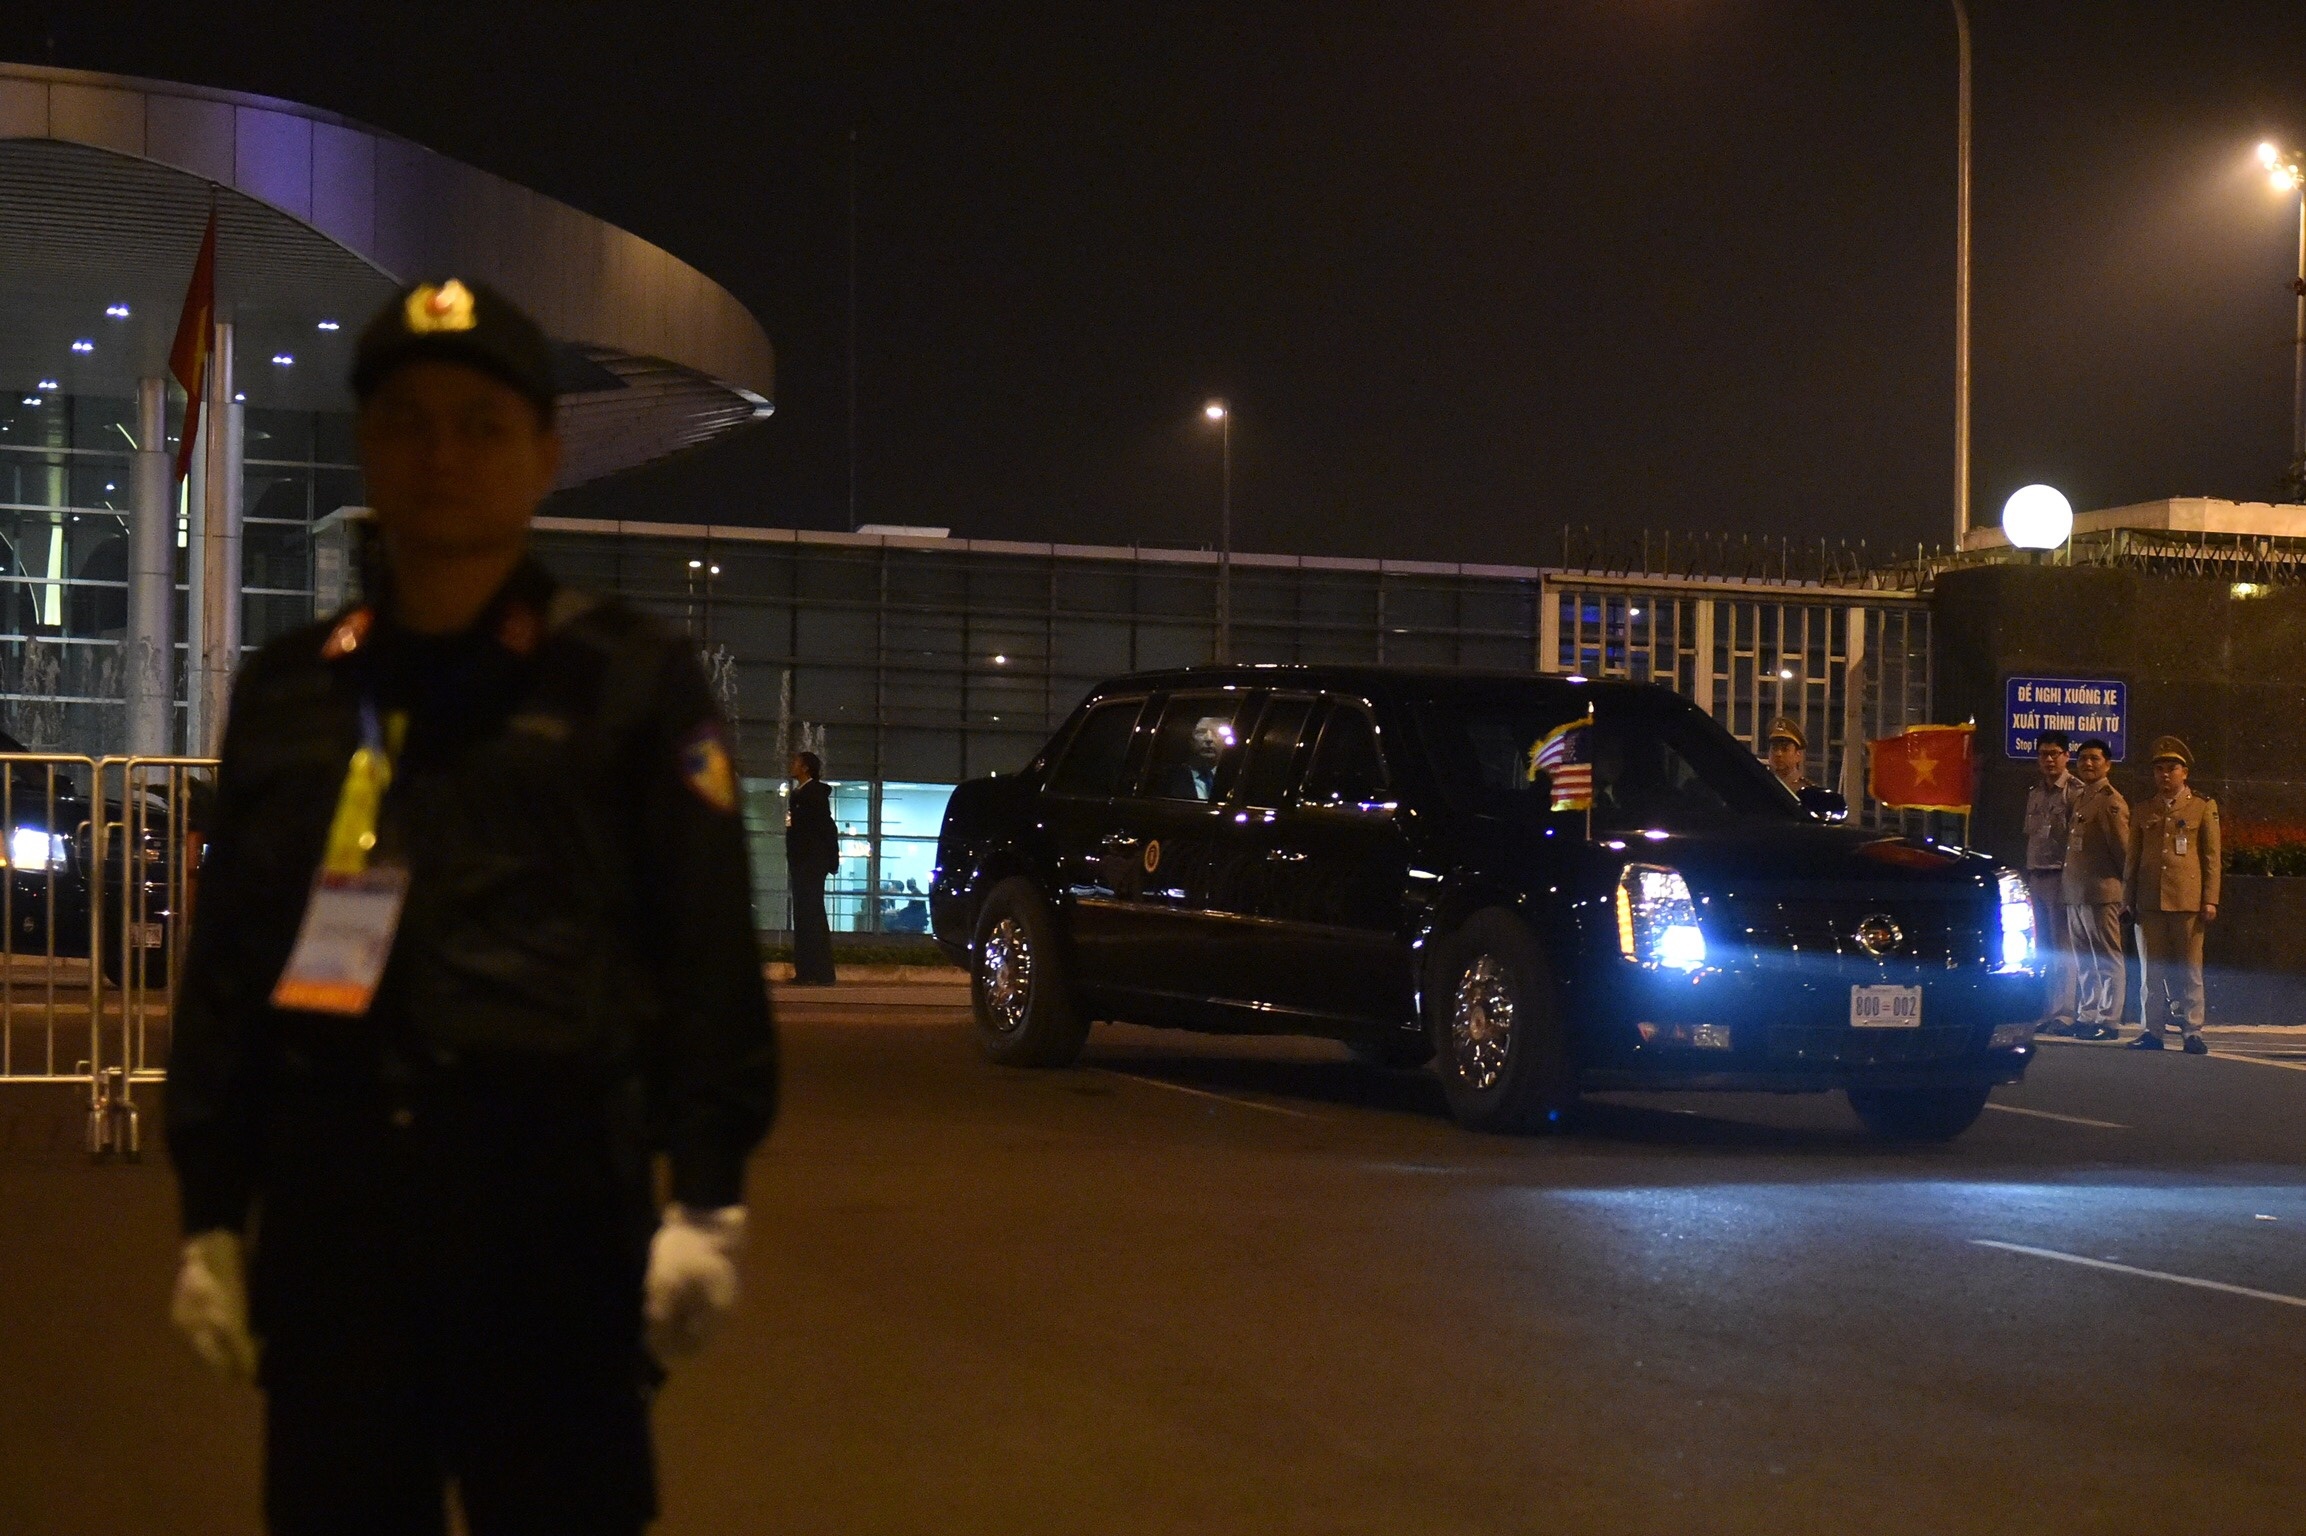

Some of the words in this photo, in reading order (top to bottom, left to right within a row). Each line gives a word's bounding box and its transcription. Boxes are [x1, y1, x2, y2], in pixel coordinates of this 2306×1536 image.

[2018, 682, 2032, 702] ĐỀ
[2035, 687, 2061, 706] NGHỊ
[2064, 684, 2101, 705] XUỐNG
[2103, 689, 2117, 706] XE
[2012, 709, 2040, 729] XUẤT
[2044, 711, 2075, 731] TRÌNH
[2078, 711, 2103, 732] GIẤY
[2106, 713, 2119, 733] TỜ
[2016, 737, 2032, 753] Stop
